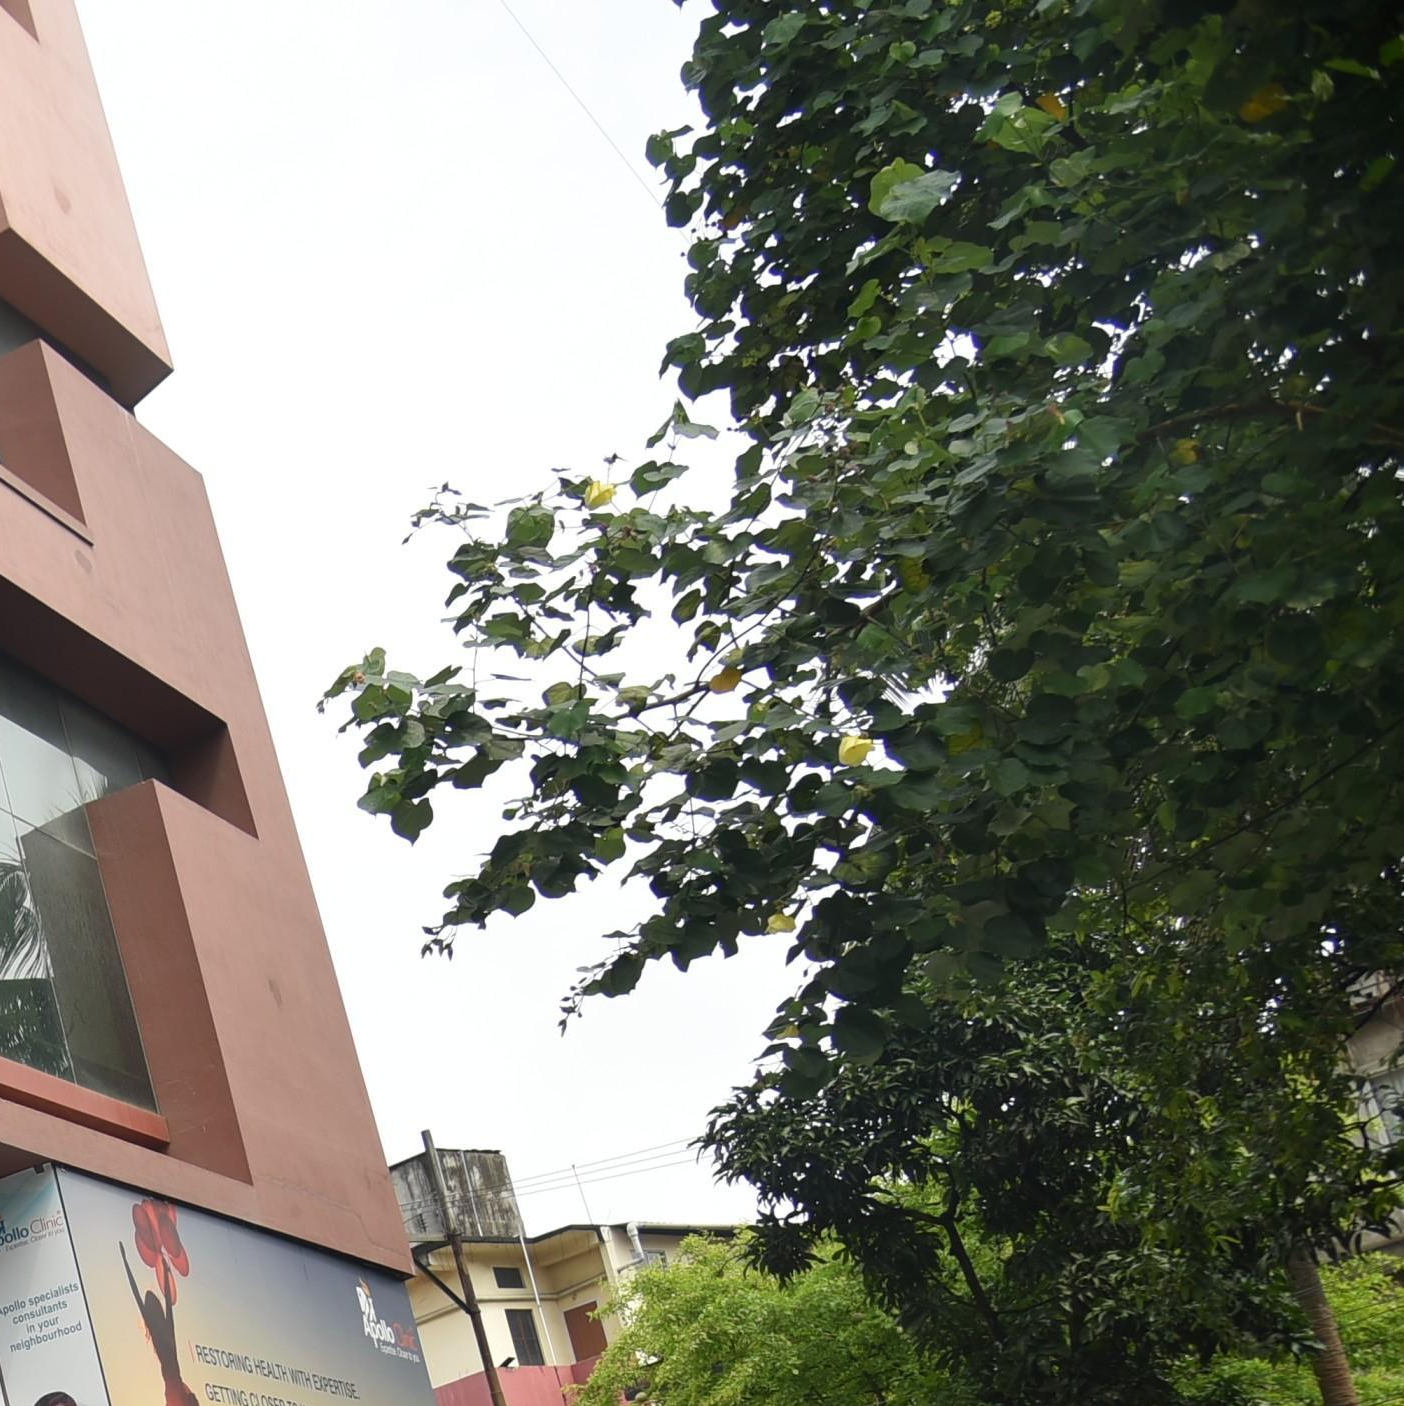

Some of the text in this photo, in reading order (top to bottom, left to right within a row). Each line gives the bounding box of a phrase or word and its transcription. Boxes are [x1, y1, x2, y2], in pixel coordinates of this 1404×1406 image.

[30, 1214, 63, 1235] Clinic
[28, 1282, 79, 1308] specialists
[12, 1300, 68, 1325] consultants
[38, 1316, 60, 1333] your
[10, 1321, 82, 1353] neighbourhood
[195, 1345, 361, 1400] RESTORING HEALTH WITH EXPERTISE.
